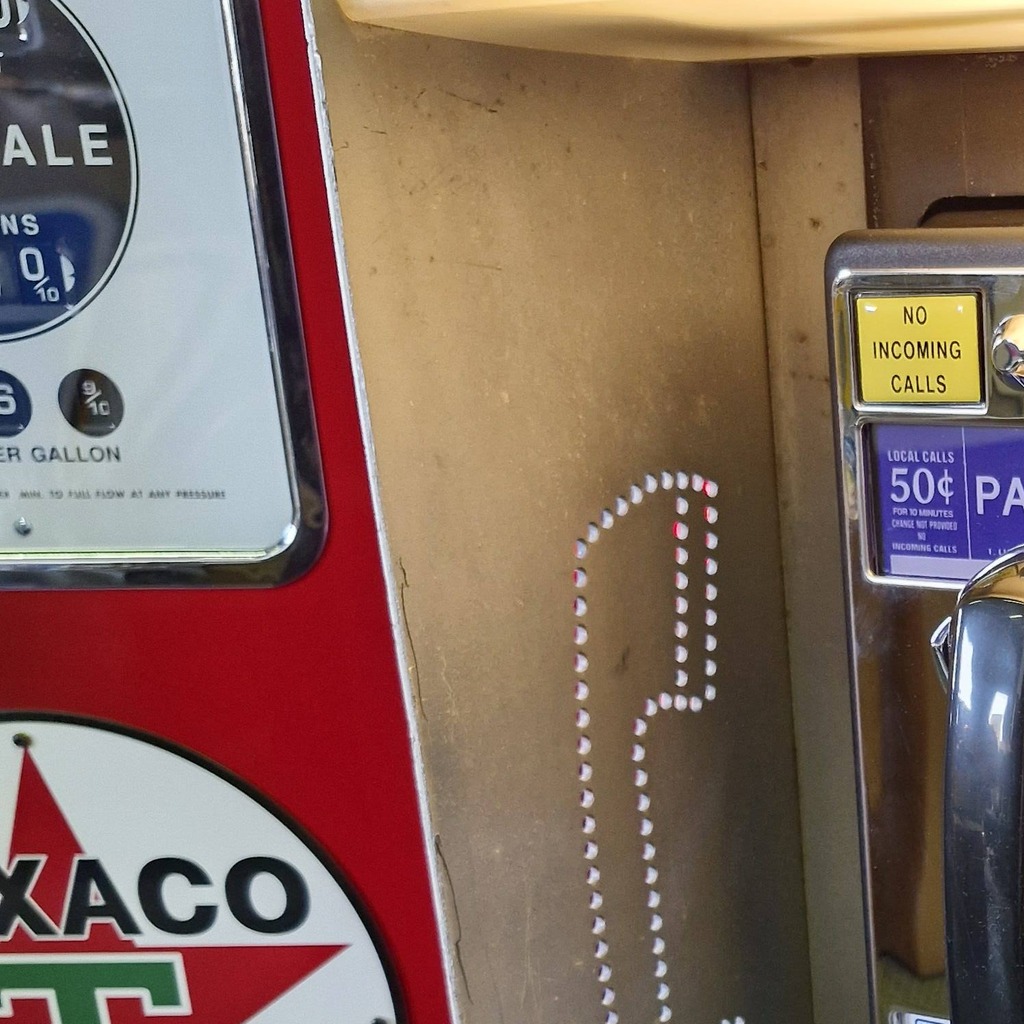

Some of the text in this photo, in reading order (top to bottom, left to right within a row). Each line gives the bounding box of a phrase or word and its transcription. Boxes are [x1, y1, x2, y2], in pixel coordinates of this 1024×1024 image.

[903, 305, 928, 325] NO
[872, 340, 962, 360] INCOMING
[890, 374, 947, 394] CALLS
[30, 446, 122, 464] GALLON
[887, 449, 955, 464] LOCAL CALLS
[890, 467, 955, 506] 50¢
[892, 507, 909, 516] FOR
[918, 509, 954, 518] MINUTES
[892, 542, 957, 554] INCOMING CALLS
